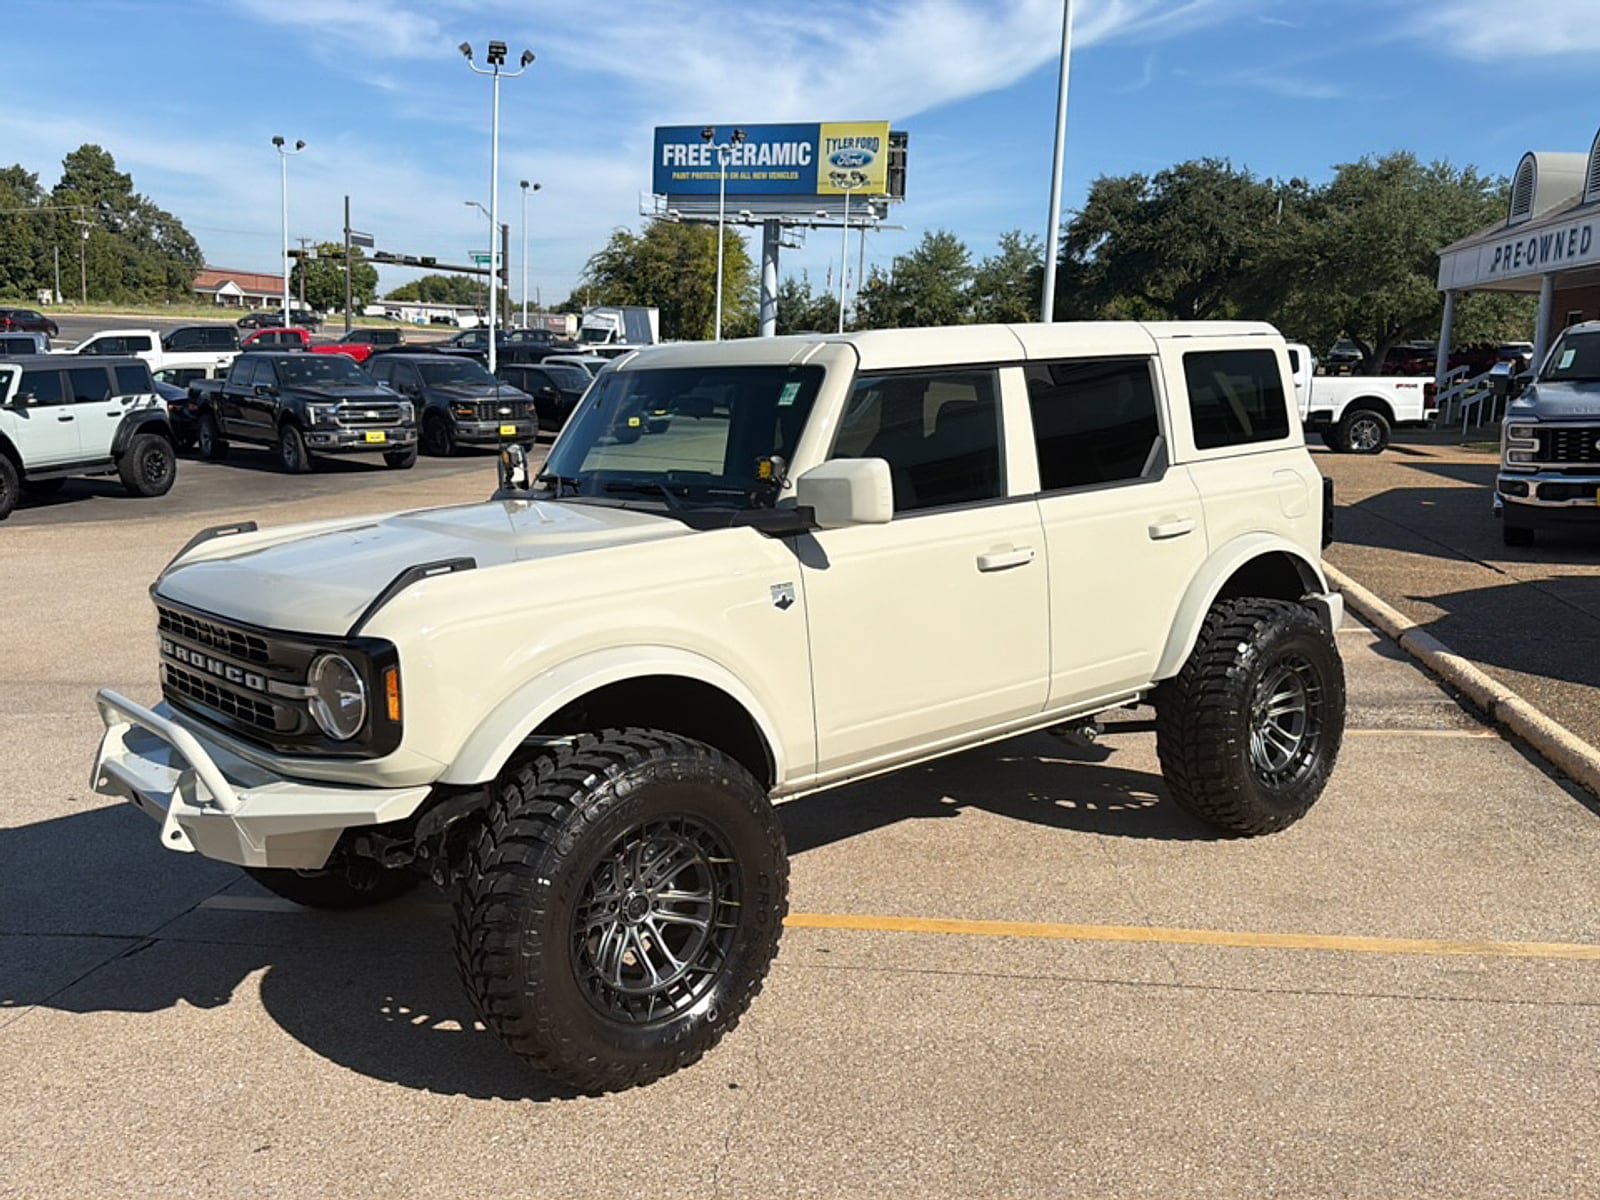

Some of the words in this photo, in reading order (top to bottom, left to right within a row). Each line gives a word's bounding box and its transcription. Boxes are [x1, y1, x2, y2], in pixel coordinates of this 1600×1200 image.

[663, 143, 711, 166] FREE
[717, 142, 811, 166] CERAMIC
[826, 137, 854, 155] TYLER
[855, 136, 880, 153] FORD
[836, 153, 865, 166] Ford
[1490, 225, 1592, 272] PRE-OWNED
[163, 639, 265, 691] BRONCO
